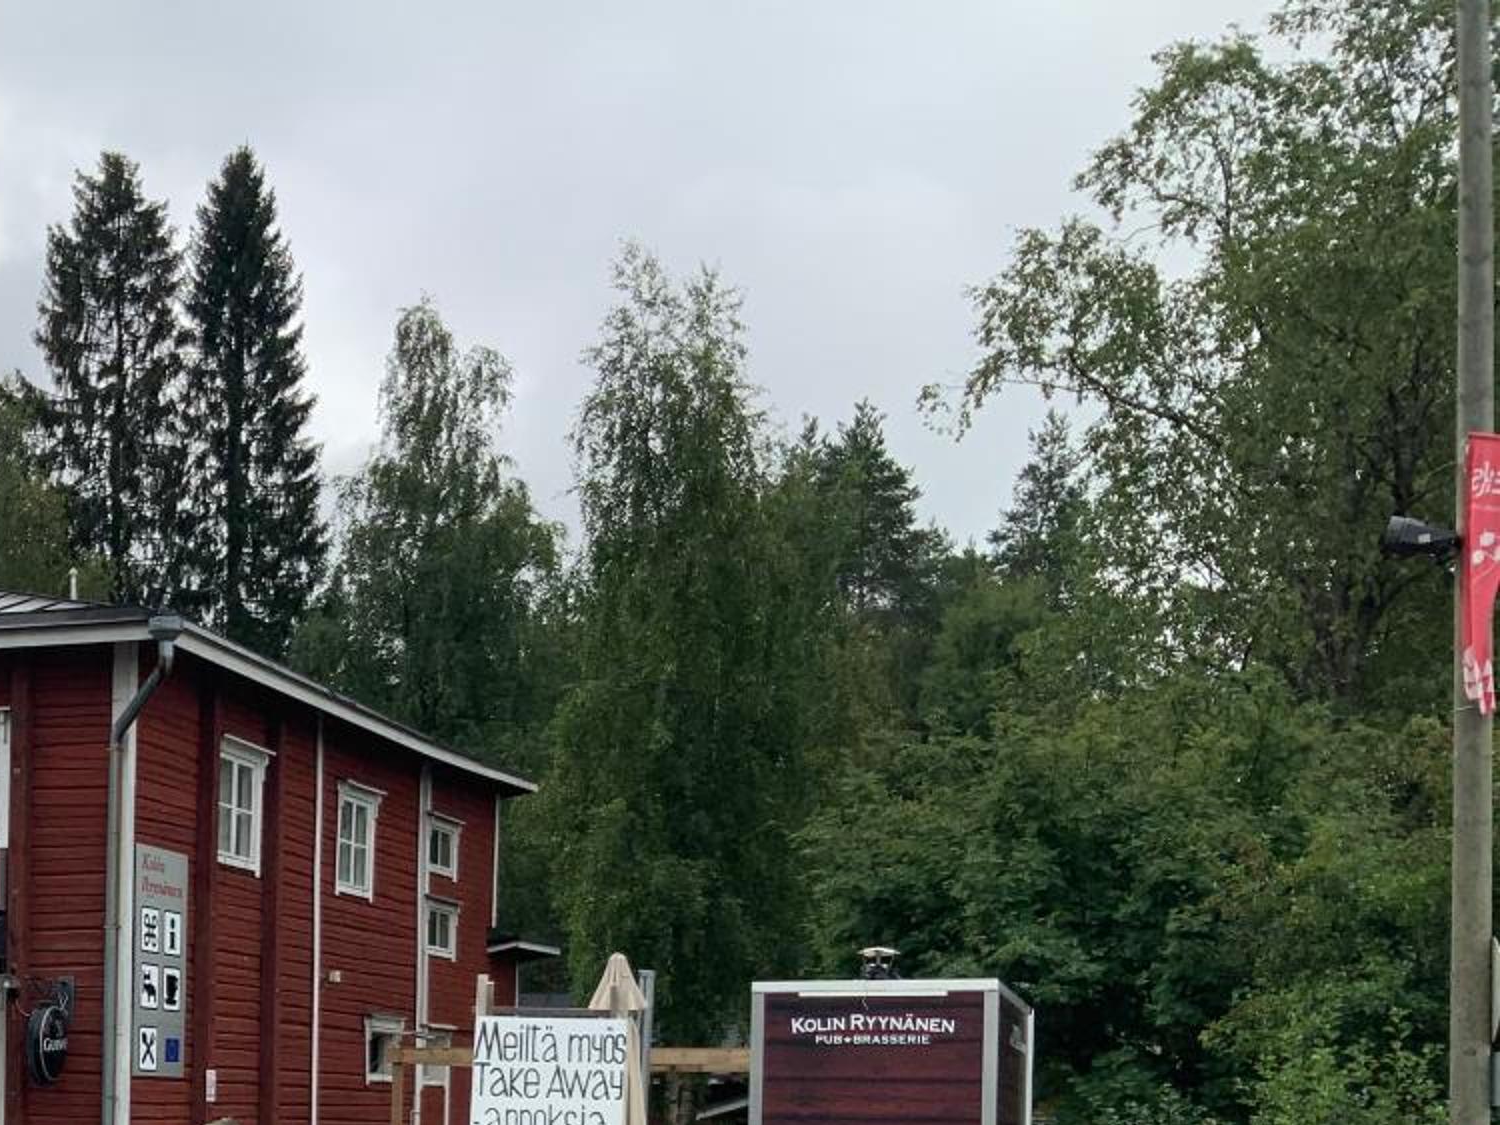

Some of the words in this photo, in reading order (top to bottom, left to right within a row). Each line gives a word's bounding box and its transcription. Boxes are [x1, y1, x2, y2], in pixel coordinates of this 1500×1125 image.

[791, 1017, 845, 1033] KOLIN
[850, 1013, 955, 1033] RYYNÄNEN
[474, 1021, 558, 1062] Meiltä
[567, 1026, 627, 1064] myös
[475, 1062, 540, 1099] Take
